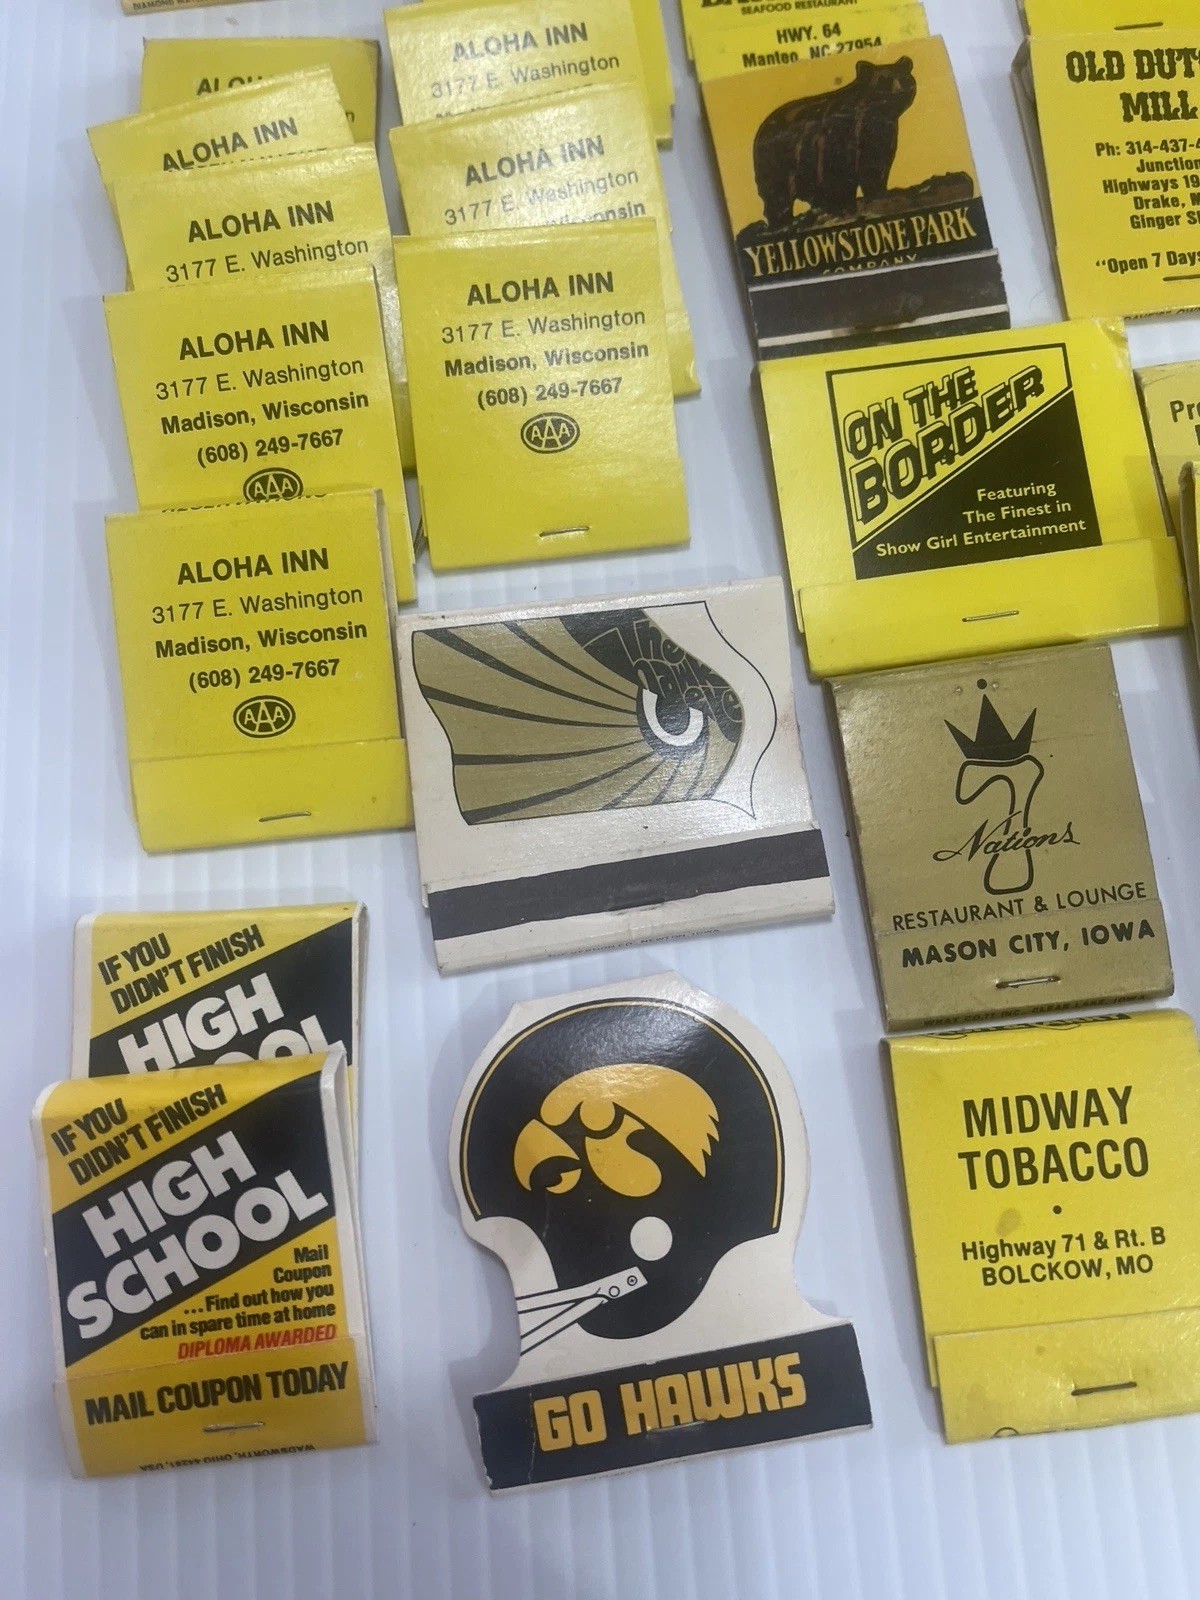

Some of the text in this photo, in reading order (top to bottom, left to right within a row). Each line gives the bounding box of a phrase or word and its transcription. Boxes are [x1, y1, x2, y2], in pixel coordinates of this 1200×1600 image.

[741, 2, 792, 15] SEAFOOD
[452, 22, 588, 62] ALOHA INN
[777, 22, 842, 44] HWY. 64
[431, 55, 620, 99] 3177 E. Washington
[1065, 47, 1200, 83] OLD DUT
[197, 75, 263, 96] ALO
[1119, 89, 1199, 123] MILL
[163, 132, 248, 171] ALOHA
[254, 117, 298, 145] INN
[465, 135, 605, 187] ALOHA INN
[1095, 142, 1121, 157] Ph:
[444, 169, 639, 226] 3177 E. Washington
[1102, 178, 1179, 195] Highways
[1133, 195, 1186, 210] Drake,
[188, 200, 334, 243] ALOHA INN
[1130, 214, 1181, 230] Ginger
[743, 206, 977, 277] YELLOWSTONE PARK
[1151, 252, 1161, 268] 7
[166, 239, 369, 284] 3177 E. Washington
[467, 271, 614, 306] ALOHA INN
[179, 320, 329, 360] ALOHA INN
[441, 310, 645, 344] 3177 E. Washington
[444, 341, 649, 377] Madison, Wisconsin
[156, 359, 364, 400] 3177 E. Washington
[477, 377, 623, 411] (608) 249-7667
[161, 392, 369, 435] Madison, Wisconsin
[843, 365, 979, 460] ON THE
[197, 429, 343, 468] (608) 249-7667
[849, 364, 1045, 526] BORDER
[977, 482, 1057, 503] Featuring
[962, 500, 1072, 525] The Finest in
[875, 519, 1087, 558] Show Girl Entertainment
[177, 548, 329, 585] ALOHA INN
[152, 588, 363, 624] 3177 E. Washington
[155, 621, 367, 658] Madison, Wisconsin
[189, 658, 340, 693] (608) 249-7667
[932, 810, 1080, 862] Nations
[892, 881, 1147, 931] RESTAURANT & LOUNGE
[98, 932, 171, 985] IF YOU
[902, 919, 1155, 968] MASON CITY, IOWA
[110, 923, 265, 1015] DIDN'T FINISH
[117, 972, 285, 1076] HIGH
[51, 1098, 128, 1157] IF YOU
[962, 1085, 1133, 1138] MIDWAY
[67, 1083, 227, 1186] DIDN'T FINISH
[958, 1137, 1149, 1190] TOBACCO
[82, 1130, 257, 1259] HIGH
[67, 1169, 329, 1339] SCHOOL
[294, 1244, 329, 1264] Mail
[961, 1226, 1166, 1264] Highway 71 & Rt. B
[273, 1265, 332, 1288] Coupon
[981, 1253, 1154, 1287] BOLCKOW, MO
[242, 1288, 268, 1308] out
[271, 1284, 303, 1305] how
[307, 1284, 334, 1302] you
[140, 1303, 336, 1340] can in spare time at home
[177, 1323, 337, 1360] DIPLOMA AWARDED
[85, 1361, 348, 1426] MAIL COUPON TODAY
[533, 1352, 806, 1452] GO HAWKS
[139, 1463, 164, 1472] USA
[203, 1453, 232, 1464] OHIO
